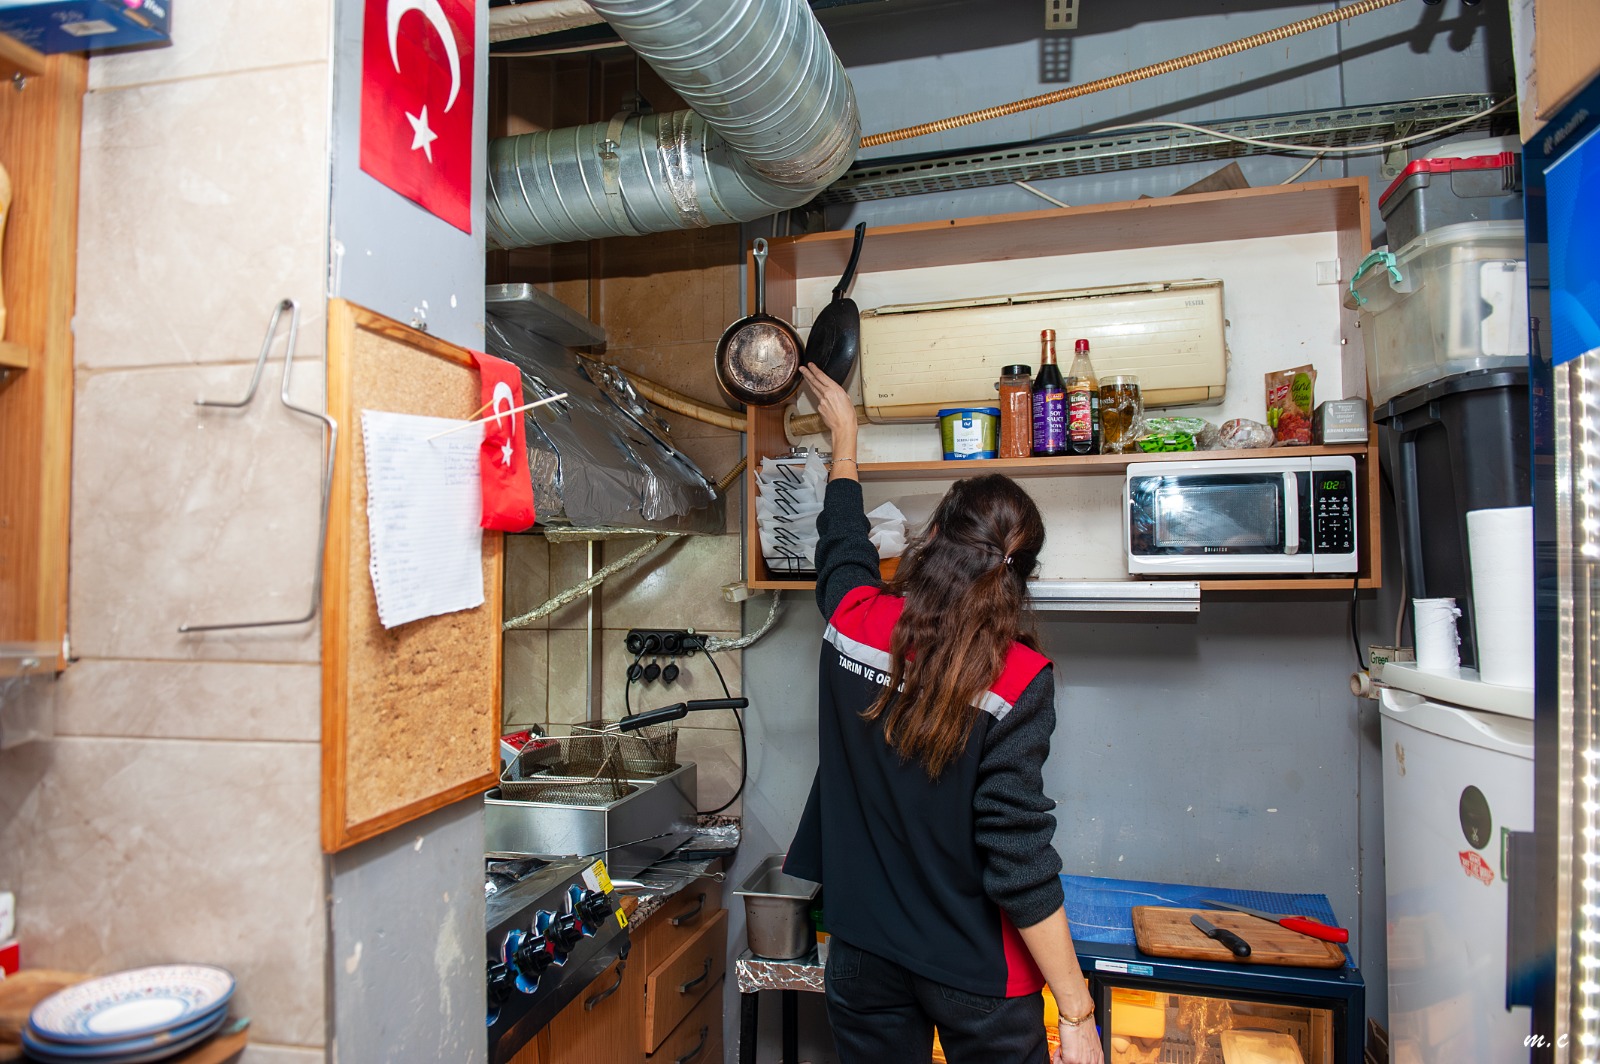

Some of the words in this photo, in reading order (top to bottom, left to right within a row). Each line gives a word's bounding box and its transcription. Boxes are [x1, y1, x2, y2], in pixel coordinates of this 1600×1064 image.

[839, 655, 862, 675] TARIM
[864, 667, 875, 681] VE
[1370, 651, 1388, 665] Green
